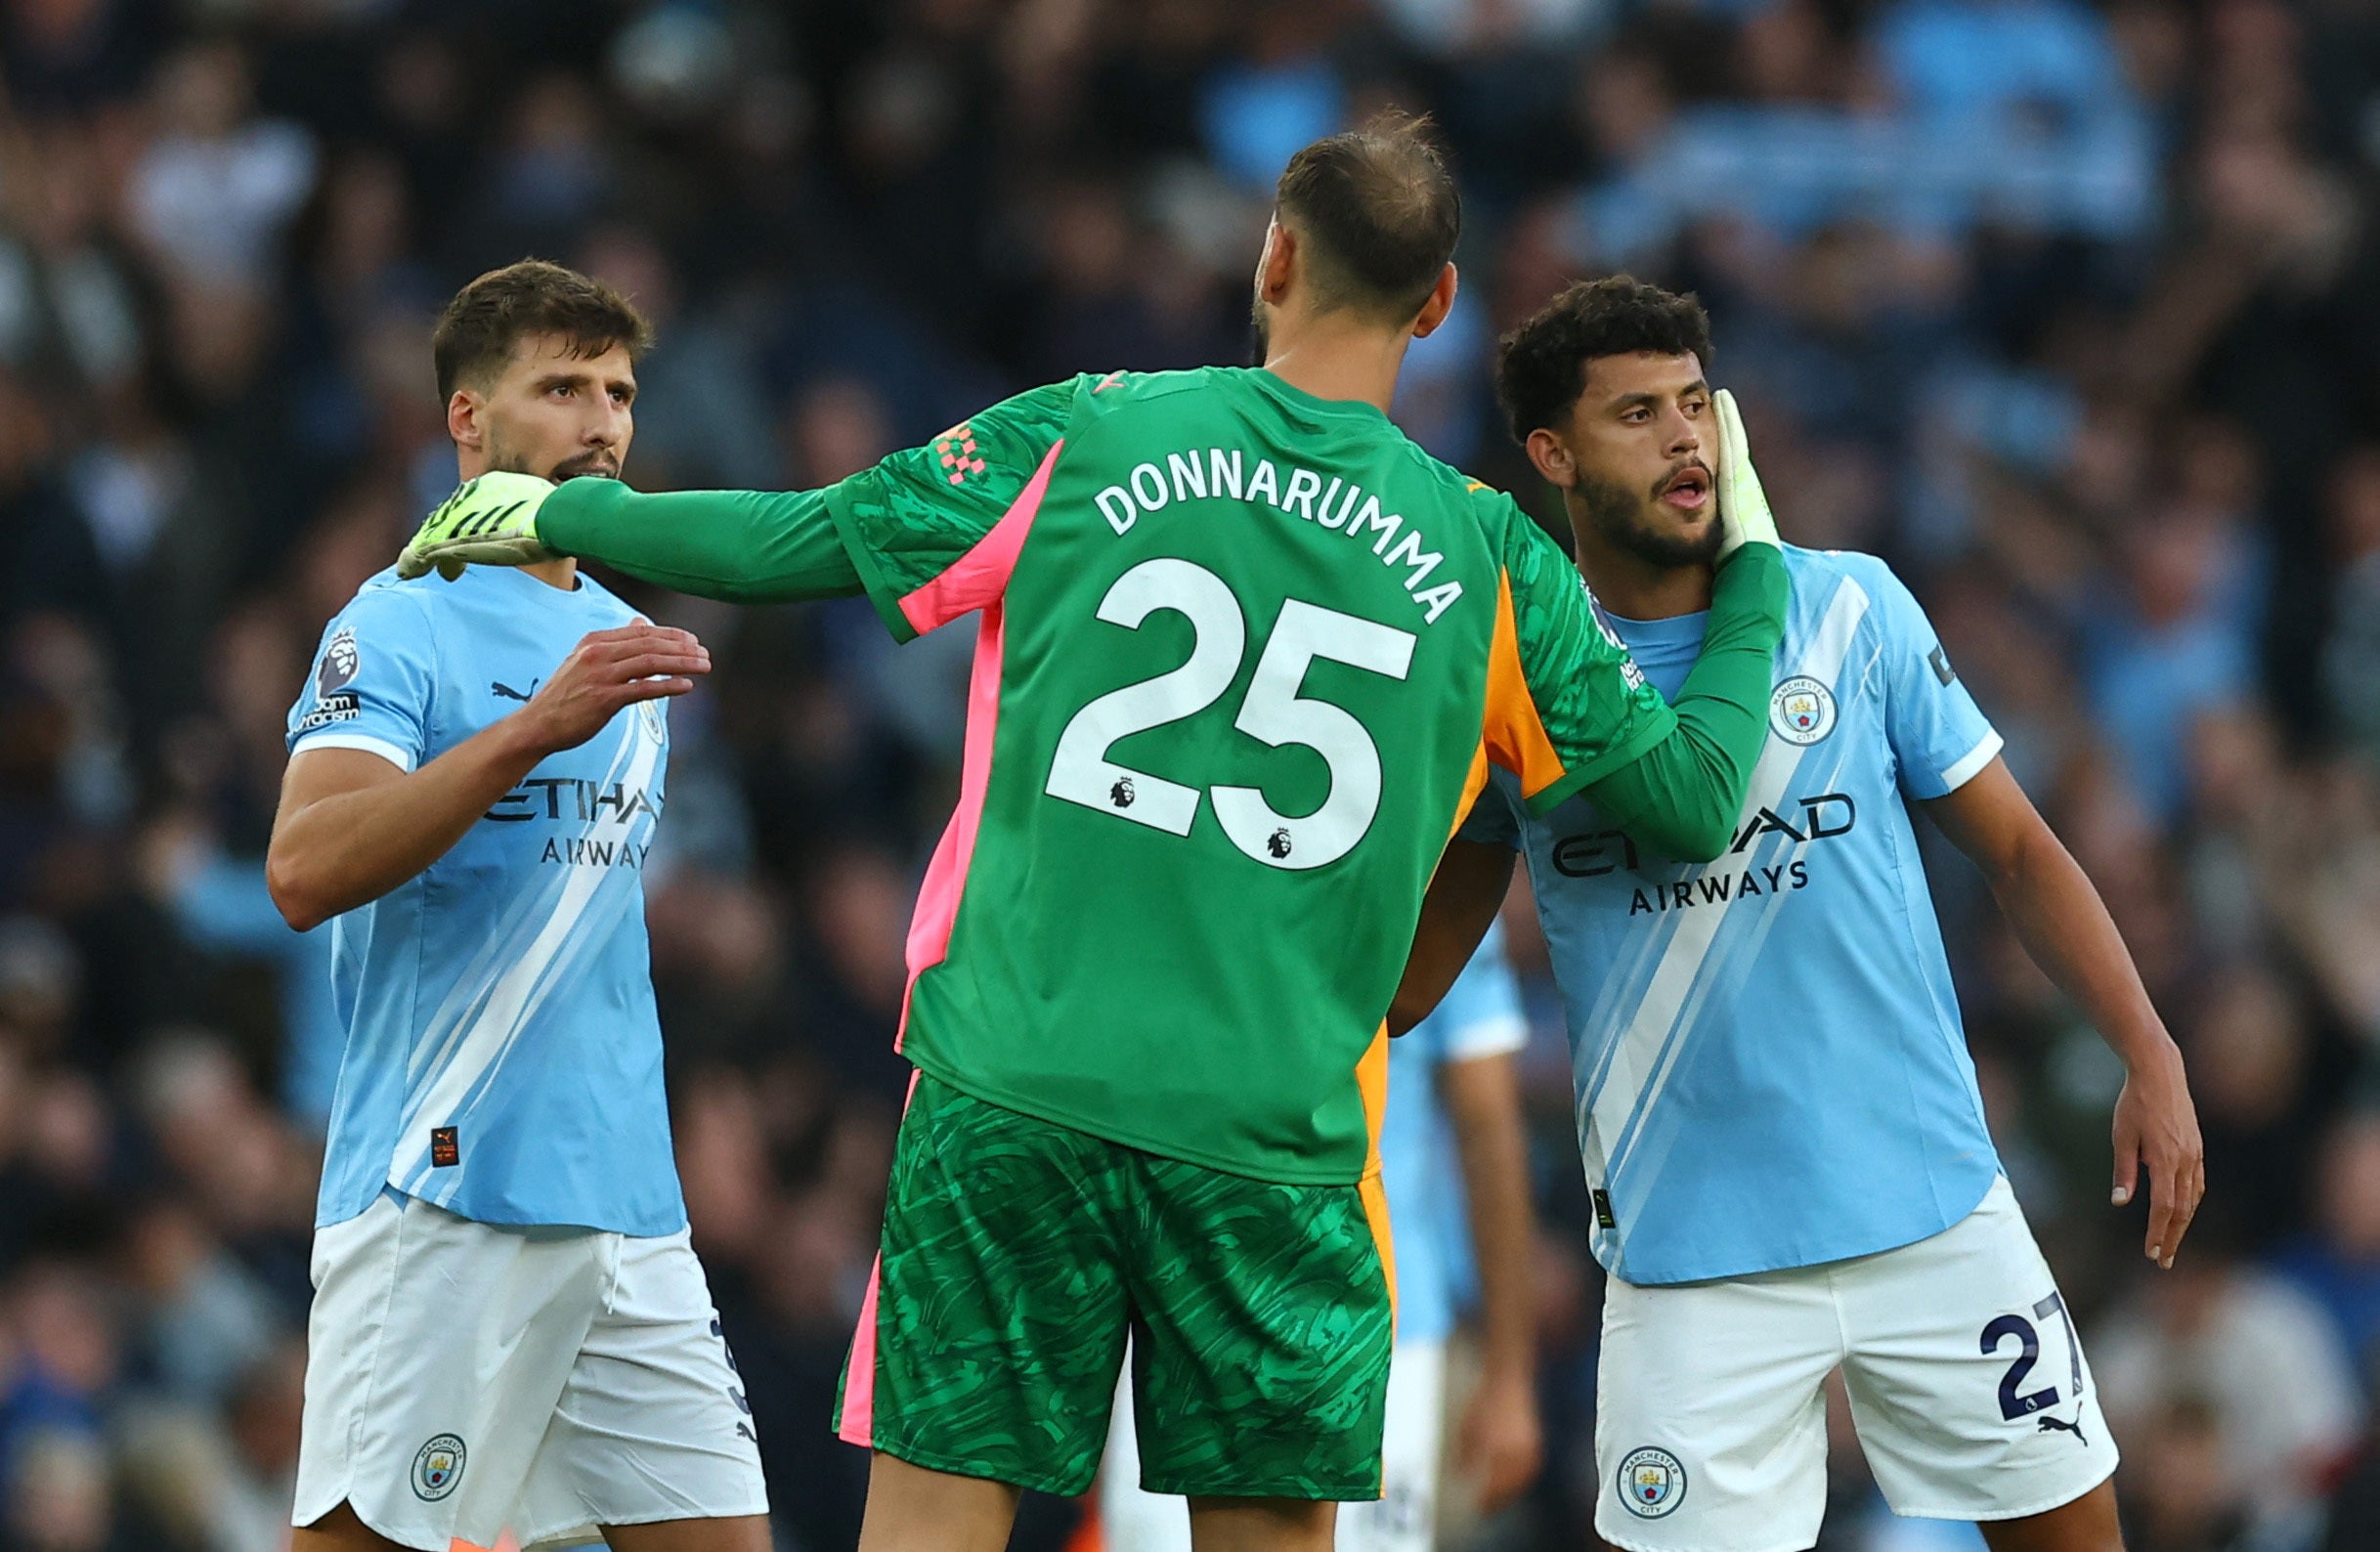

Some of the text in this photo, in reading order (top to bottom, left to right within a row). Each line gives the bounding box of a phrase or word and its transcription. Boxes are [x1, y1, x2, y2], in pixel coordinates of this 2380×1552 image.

[1094, 448, 1463, 625] DONNARUMMA
[1044, 556, 1418, 872] 25
[1772, 680, 1828, 705] MANCHESTER
[482, 778, 665, 825] ETIHA
[541, 837, 650, 869] AIRWAY
[1552, 793, 1856, 878] ETAD
[1629, 861, 1809, 916] AIRWAYS
[1979, 1290, 2084, 1422] 27
[1623, 1452, 1679, 1475] MANCHESTER
